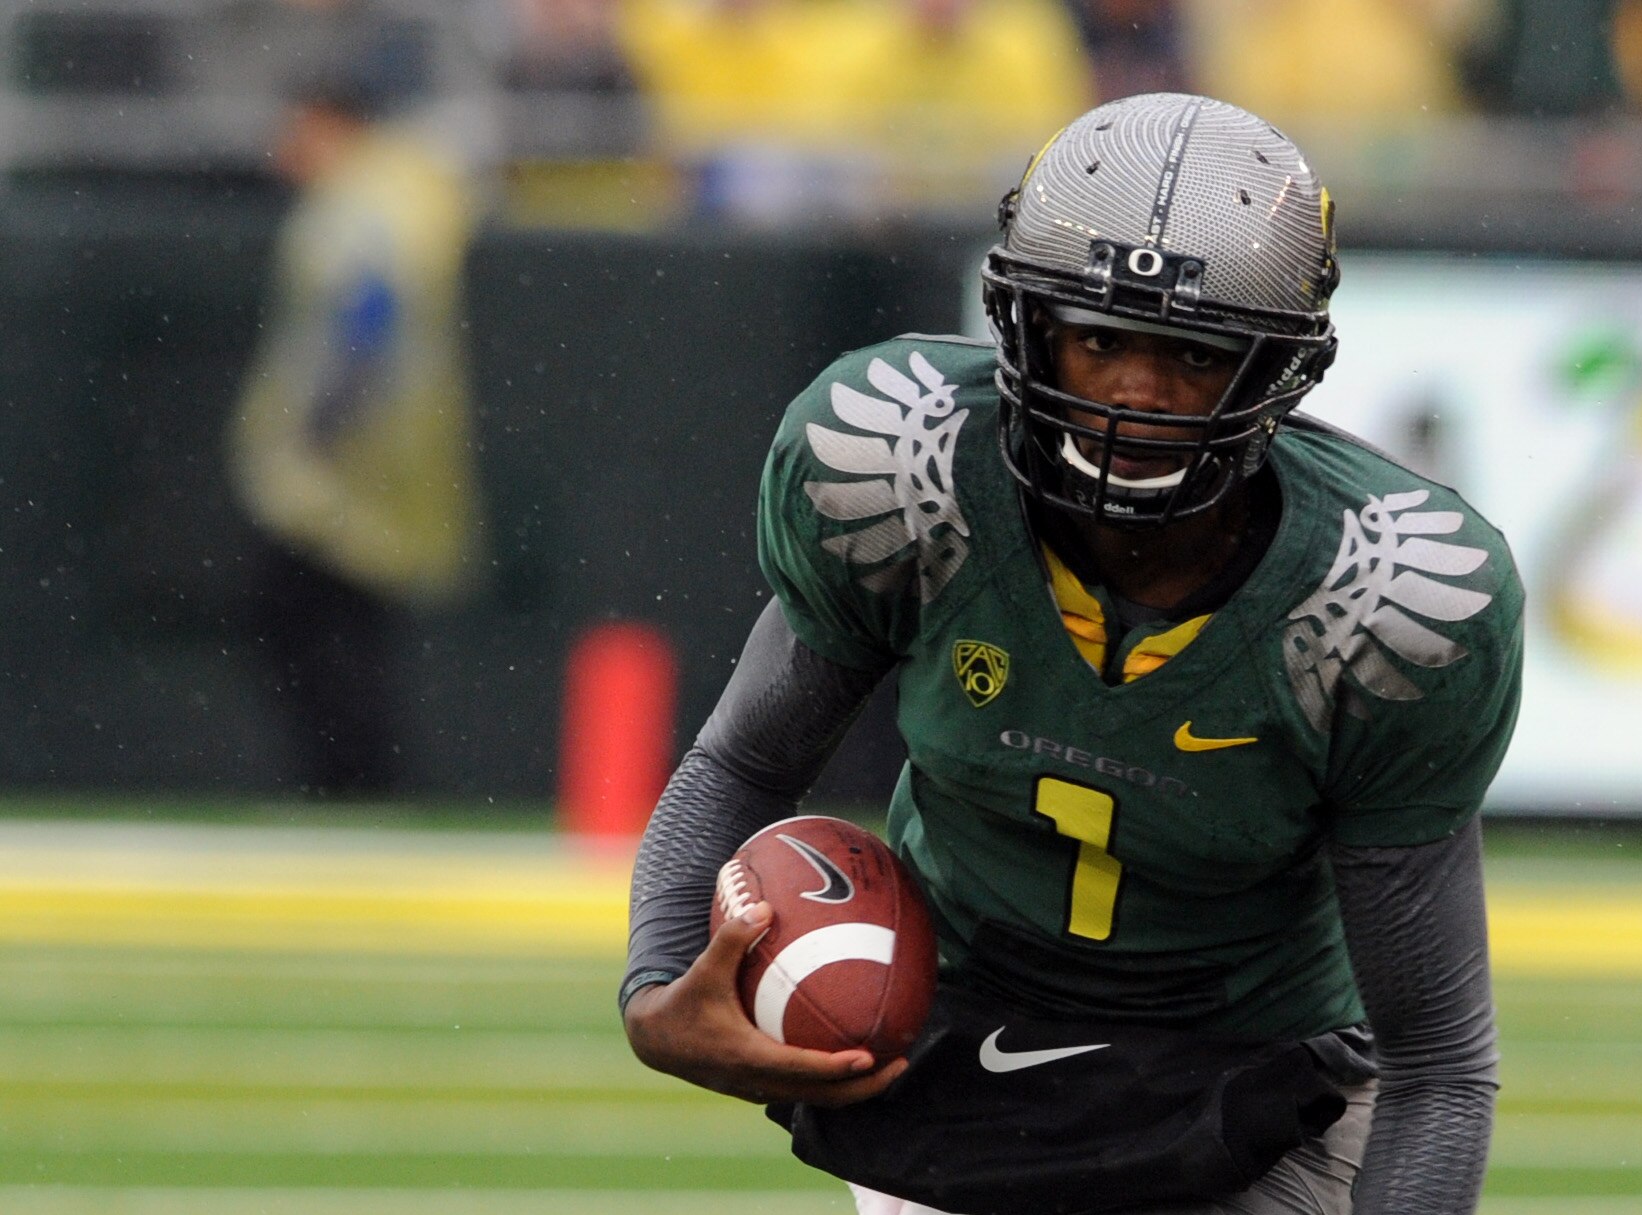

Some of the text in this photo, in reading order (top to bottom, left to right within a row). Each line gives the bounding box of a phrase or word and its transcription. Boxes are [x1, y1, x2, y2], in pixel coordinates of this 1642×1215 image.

[1157, 171, 1174, 206] HARD
[1128, 248, 1163, 277] O
[1103, 502, 1135, 515] ddell
[956, 643, 1005, 689] PAC
[966, 669, 995, 695] 10
[1000, 729, 1188, 797] OREGON
[1031, 774, 1123, 942] 1
